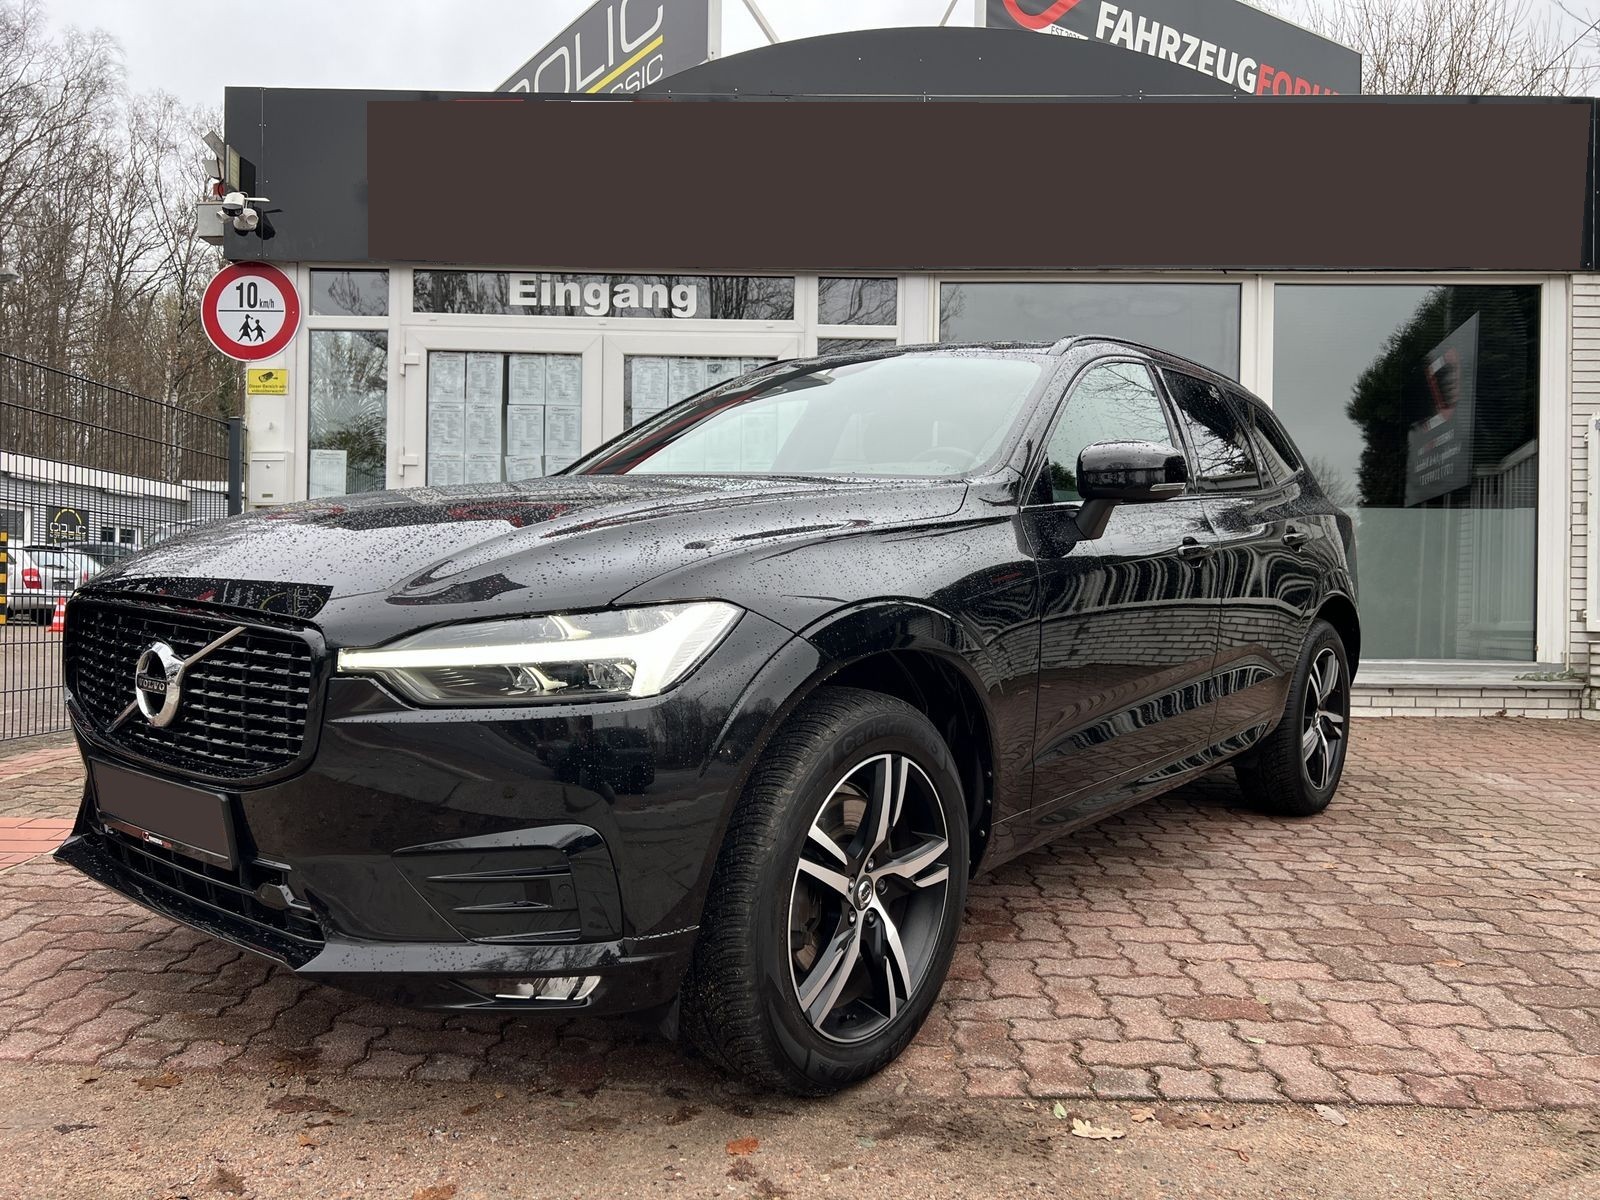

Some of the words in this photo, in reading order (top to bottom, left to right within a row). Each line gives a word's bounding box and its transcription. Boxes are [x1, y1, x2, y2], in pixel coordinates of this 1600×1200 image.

[236, 281, 258, 308] 10
[259, 298, 275, 309] km/h
[509, 273, 698, 318] Eingang
[139, 677, 165, 691] VOLVO
